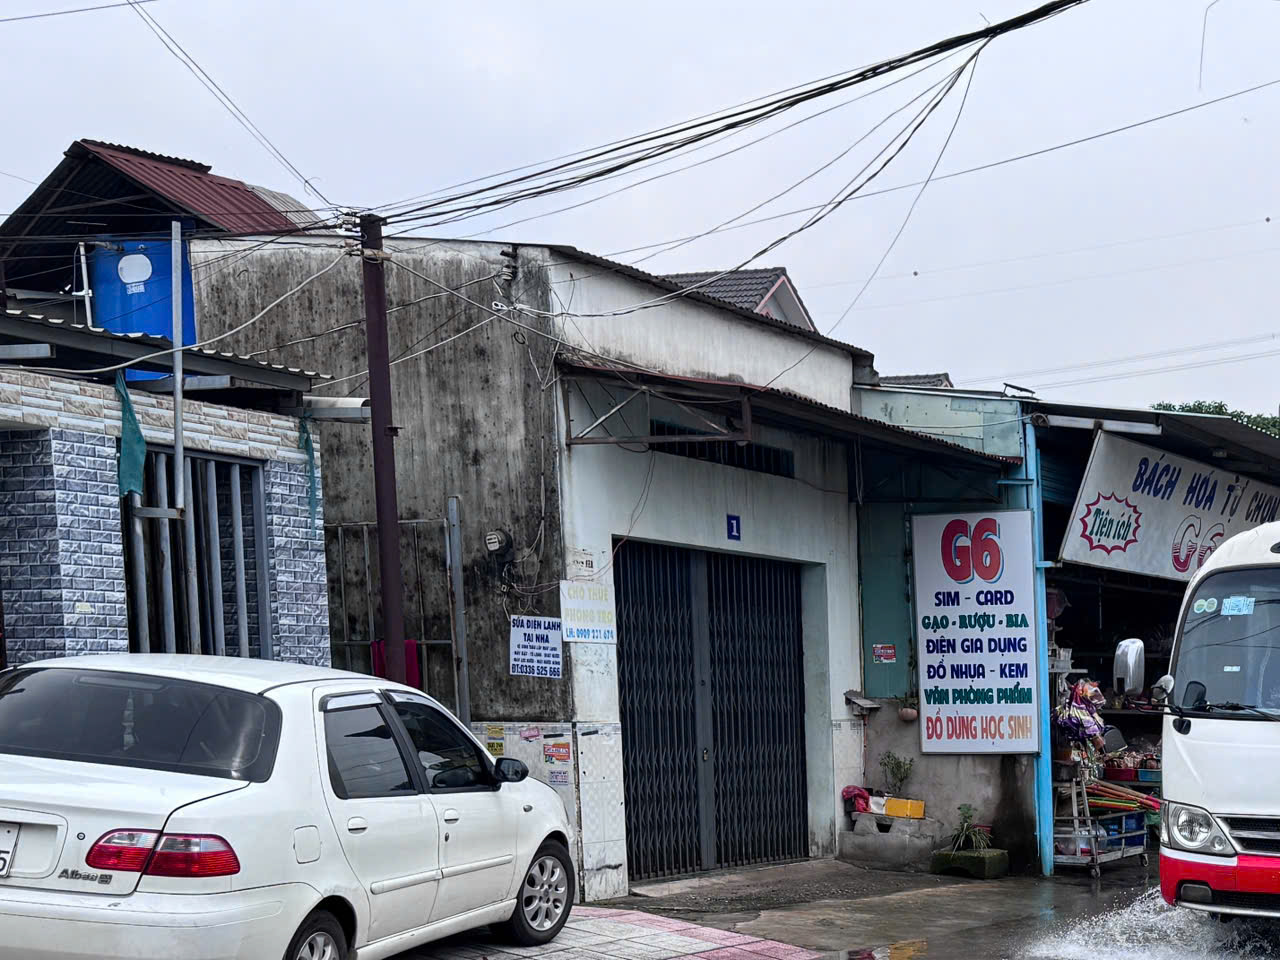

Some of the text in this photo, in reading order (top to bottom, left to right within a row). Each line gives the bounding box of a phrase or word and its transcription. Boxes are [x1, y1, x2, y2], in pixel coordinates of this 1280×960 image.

[1132, 454, 1182, 500] BÁCH
[1183, 470, 1218, 511] HÓA
[730, 520, 739, 536] 1
[1089, 508, 1132, 543] Tiện ích
[941, 517, 1004, 583] G6
[934, 591, 960, 607] SIM
[975, 590, 1015, 606] CARD
[921, 615, 949, 633] GẠO
[958, 612, 996, 632] RƯỢU
[1005, 613, 1029, 628] BIA
[523, 632, 534, 644] TẠI
[926, 635, 1027, 657] ĐIỆN GIA DỤNG
[536, 665, 548, 676] 525
[927, 659, 947, 679] ĐỒ
[1000, 663, 1028, 678] KEM
[924, 681, 1032, 704] VĂN PHÒNG PHẨM
[926, 707, 1032, 745] ĐỒ DÙNG HỌC SINH
